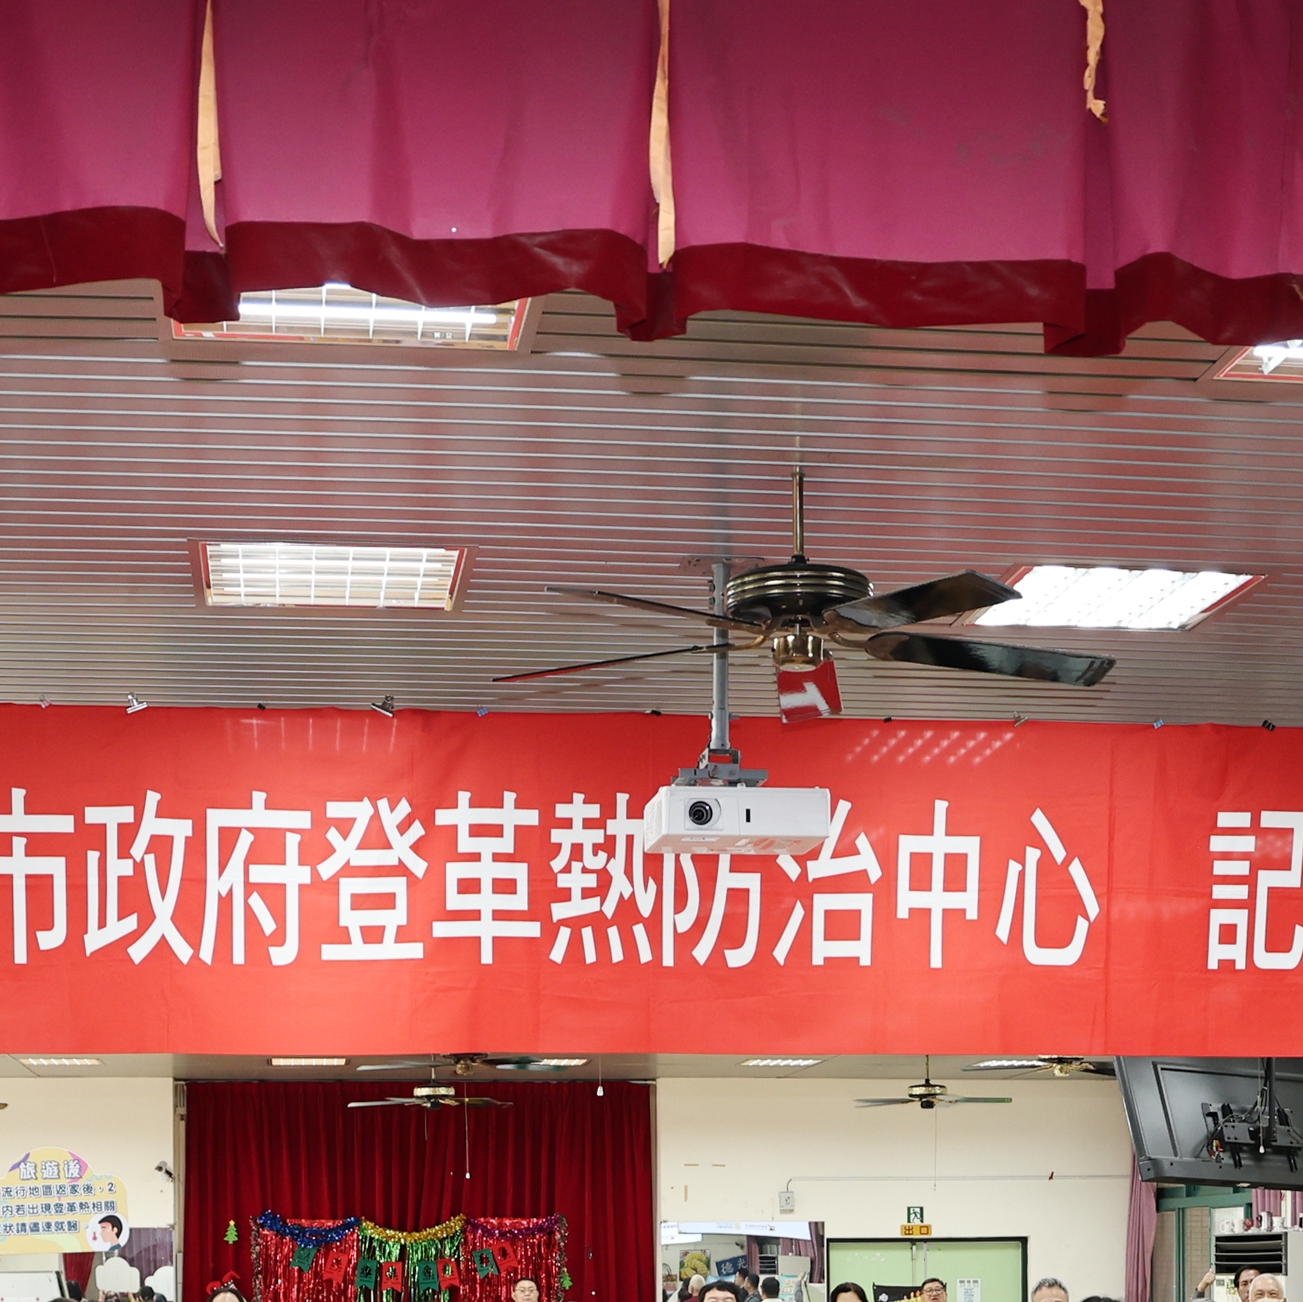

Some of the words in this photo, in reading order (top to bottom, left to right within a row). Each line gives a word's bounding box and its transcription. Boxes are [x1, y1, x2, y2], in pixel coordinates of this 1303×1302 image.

[19, 1159, 82, 1181] 旅遊後
[904, 1225, 929, 1236] 出口
